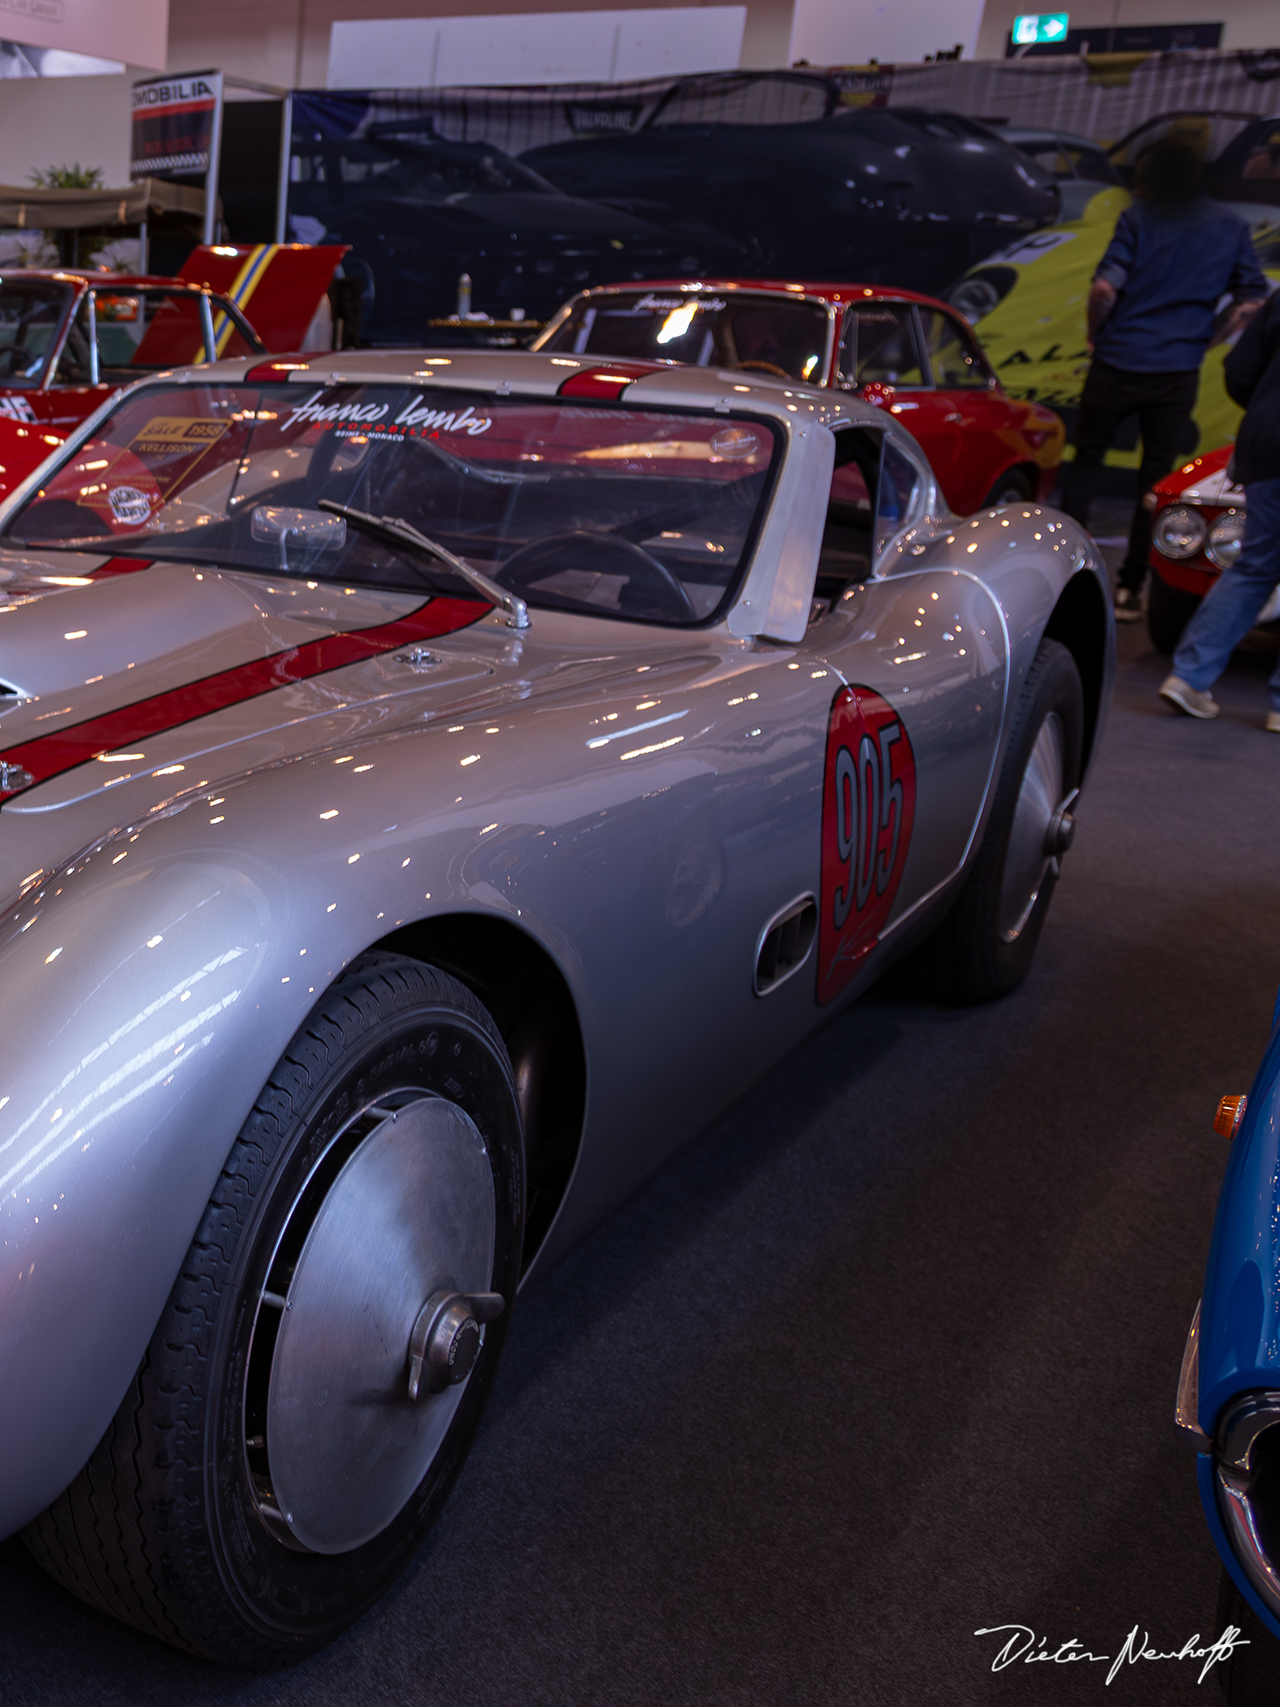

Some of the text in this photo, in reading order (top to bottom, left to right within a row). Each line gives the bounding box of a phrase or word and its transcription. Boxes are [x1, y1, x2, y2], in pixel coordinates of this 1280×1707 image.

[143, 425, 223, 437] SALE 1958
[312, 421, 440, 440] AUTOMOBILIA
[367, 431, 405, 442] MONACO
[138, 443, 196, 454] KELLISON
[834, 719, 904, 931] 905
